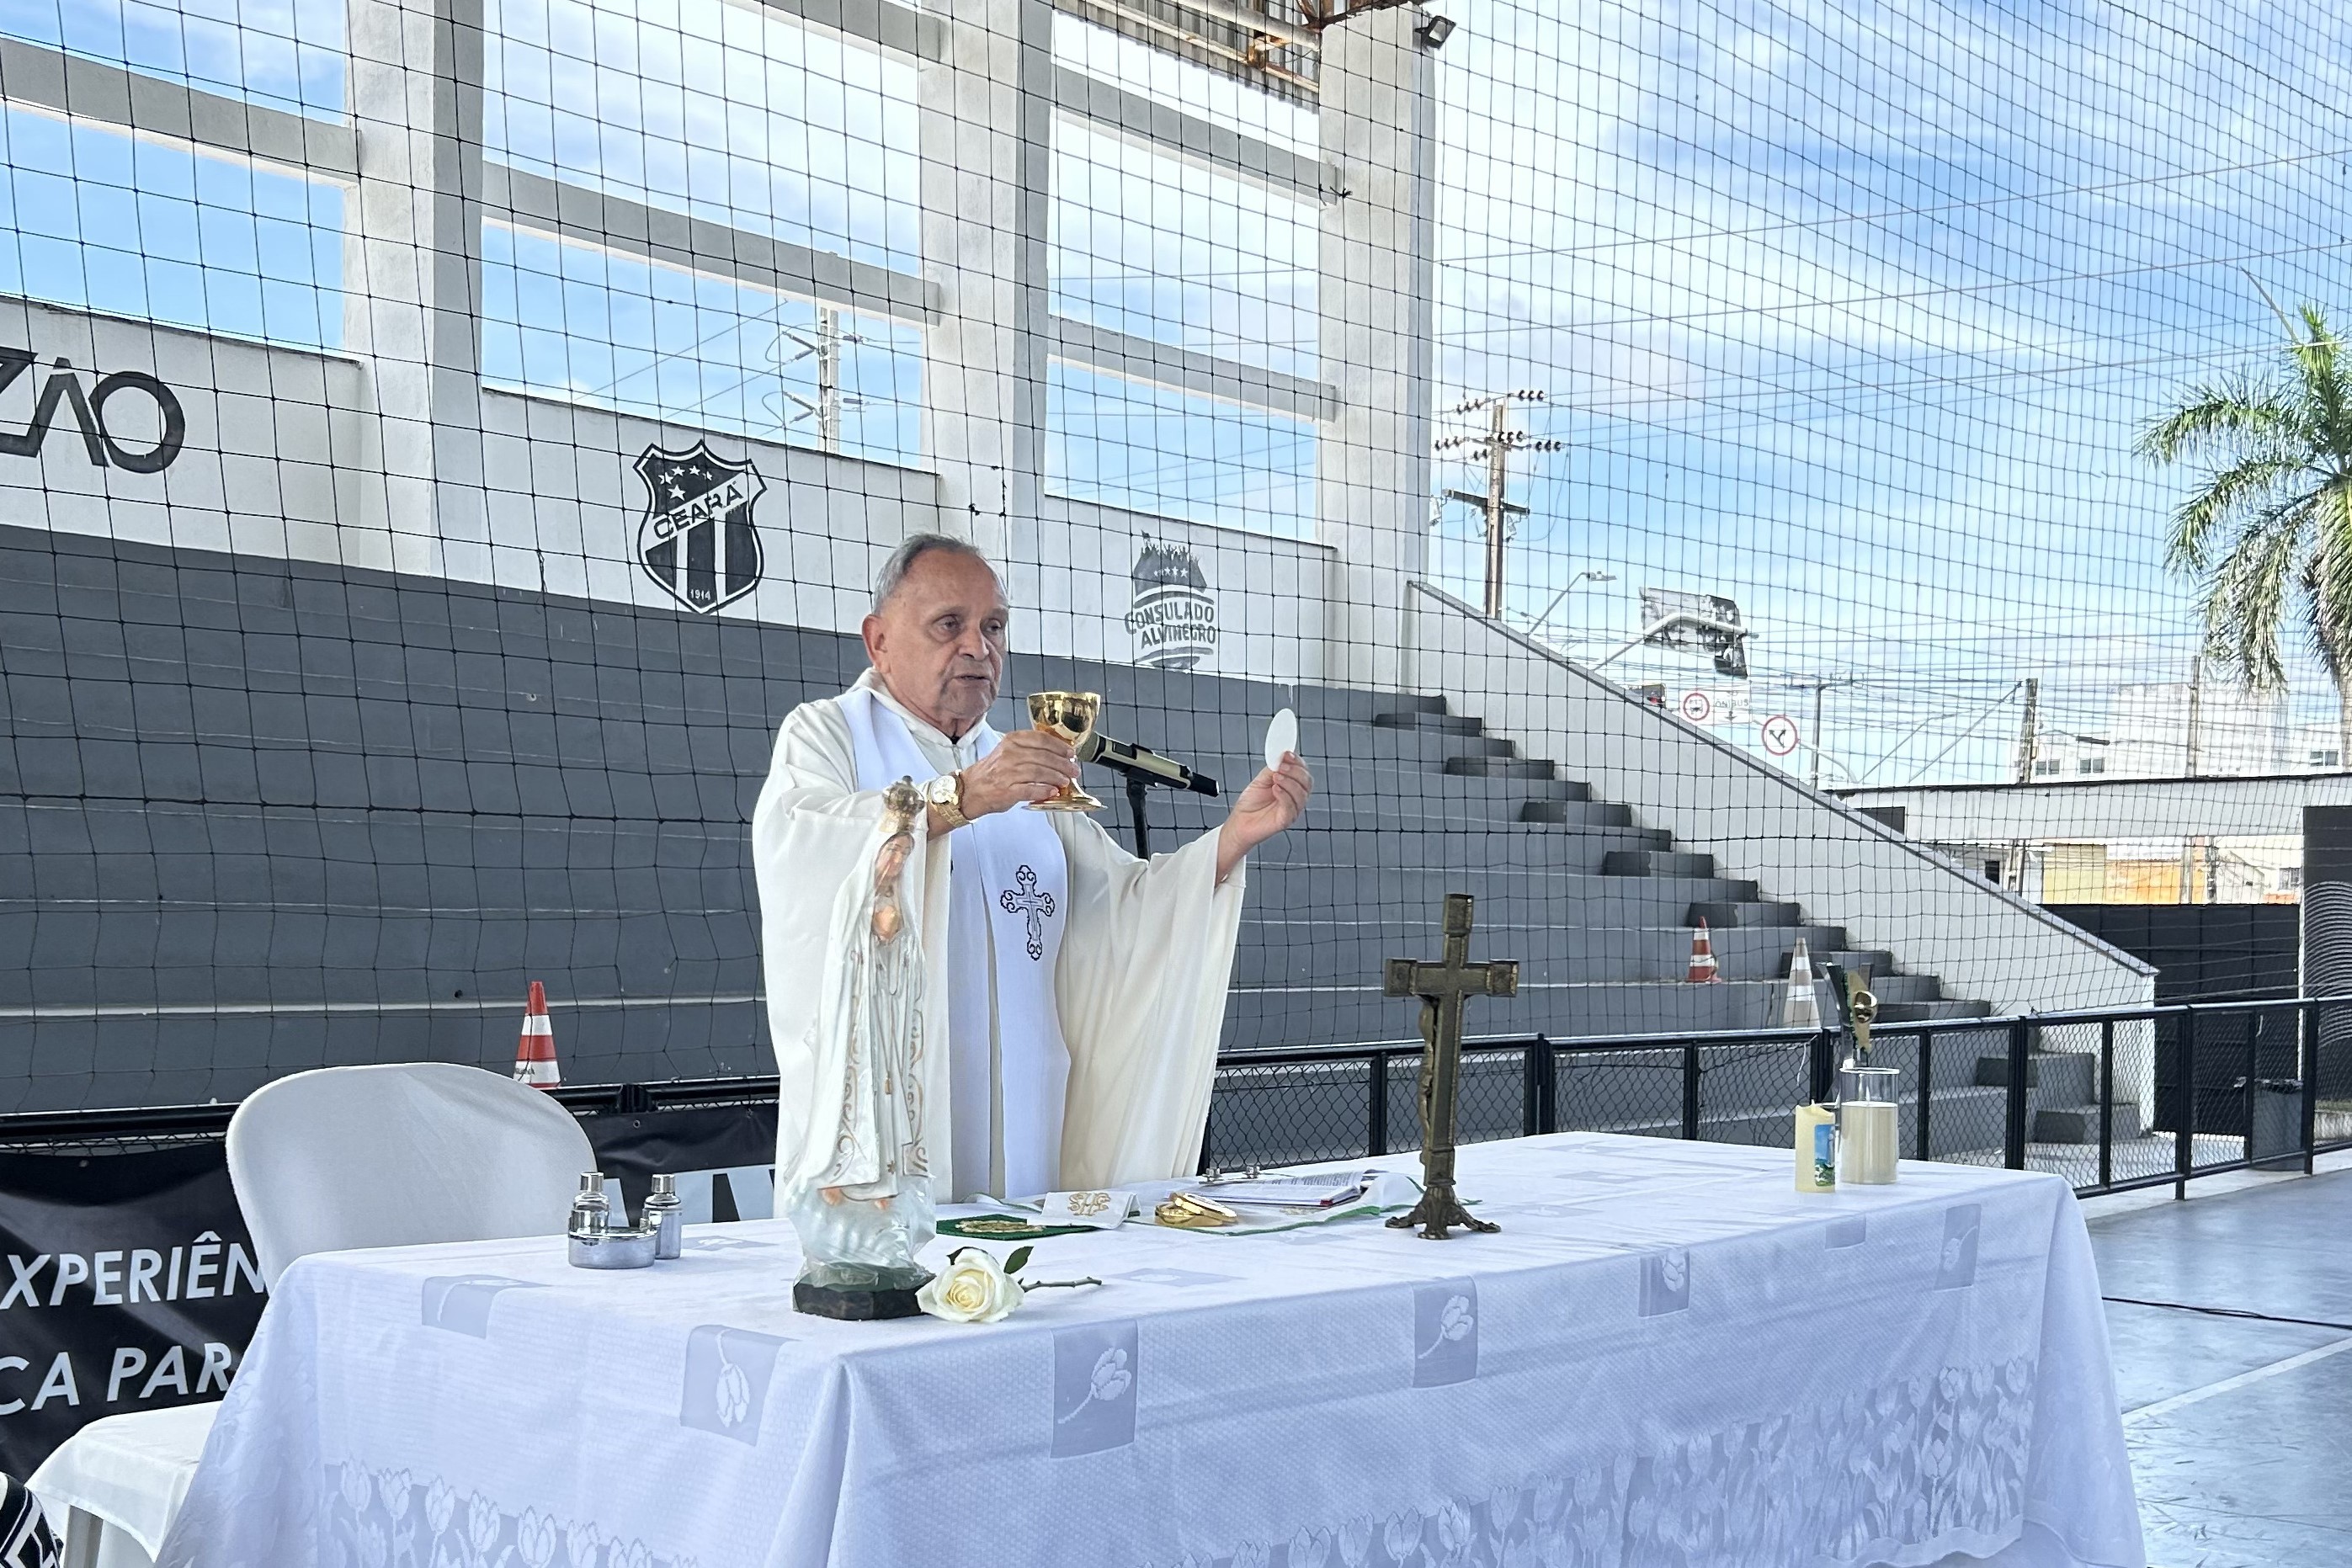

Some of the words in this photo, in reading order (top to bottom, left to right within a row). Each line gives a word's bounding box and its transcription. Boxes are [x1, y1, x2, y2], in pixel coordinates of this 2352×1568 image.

[690, 588, 711, 601] 1914
[1124, 601, 1215, 635] CONSULADO
[1141, 624, 1216, 650] ALVINEGRO
